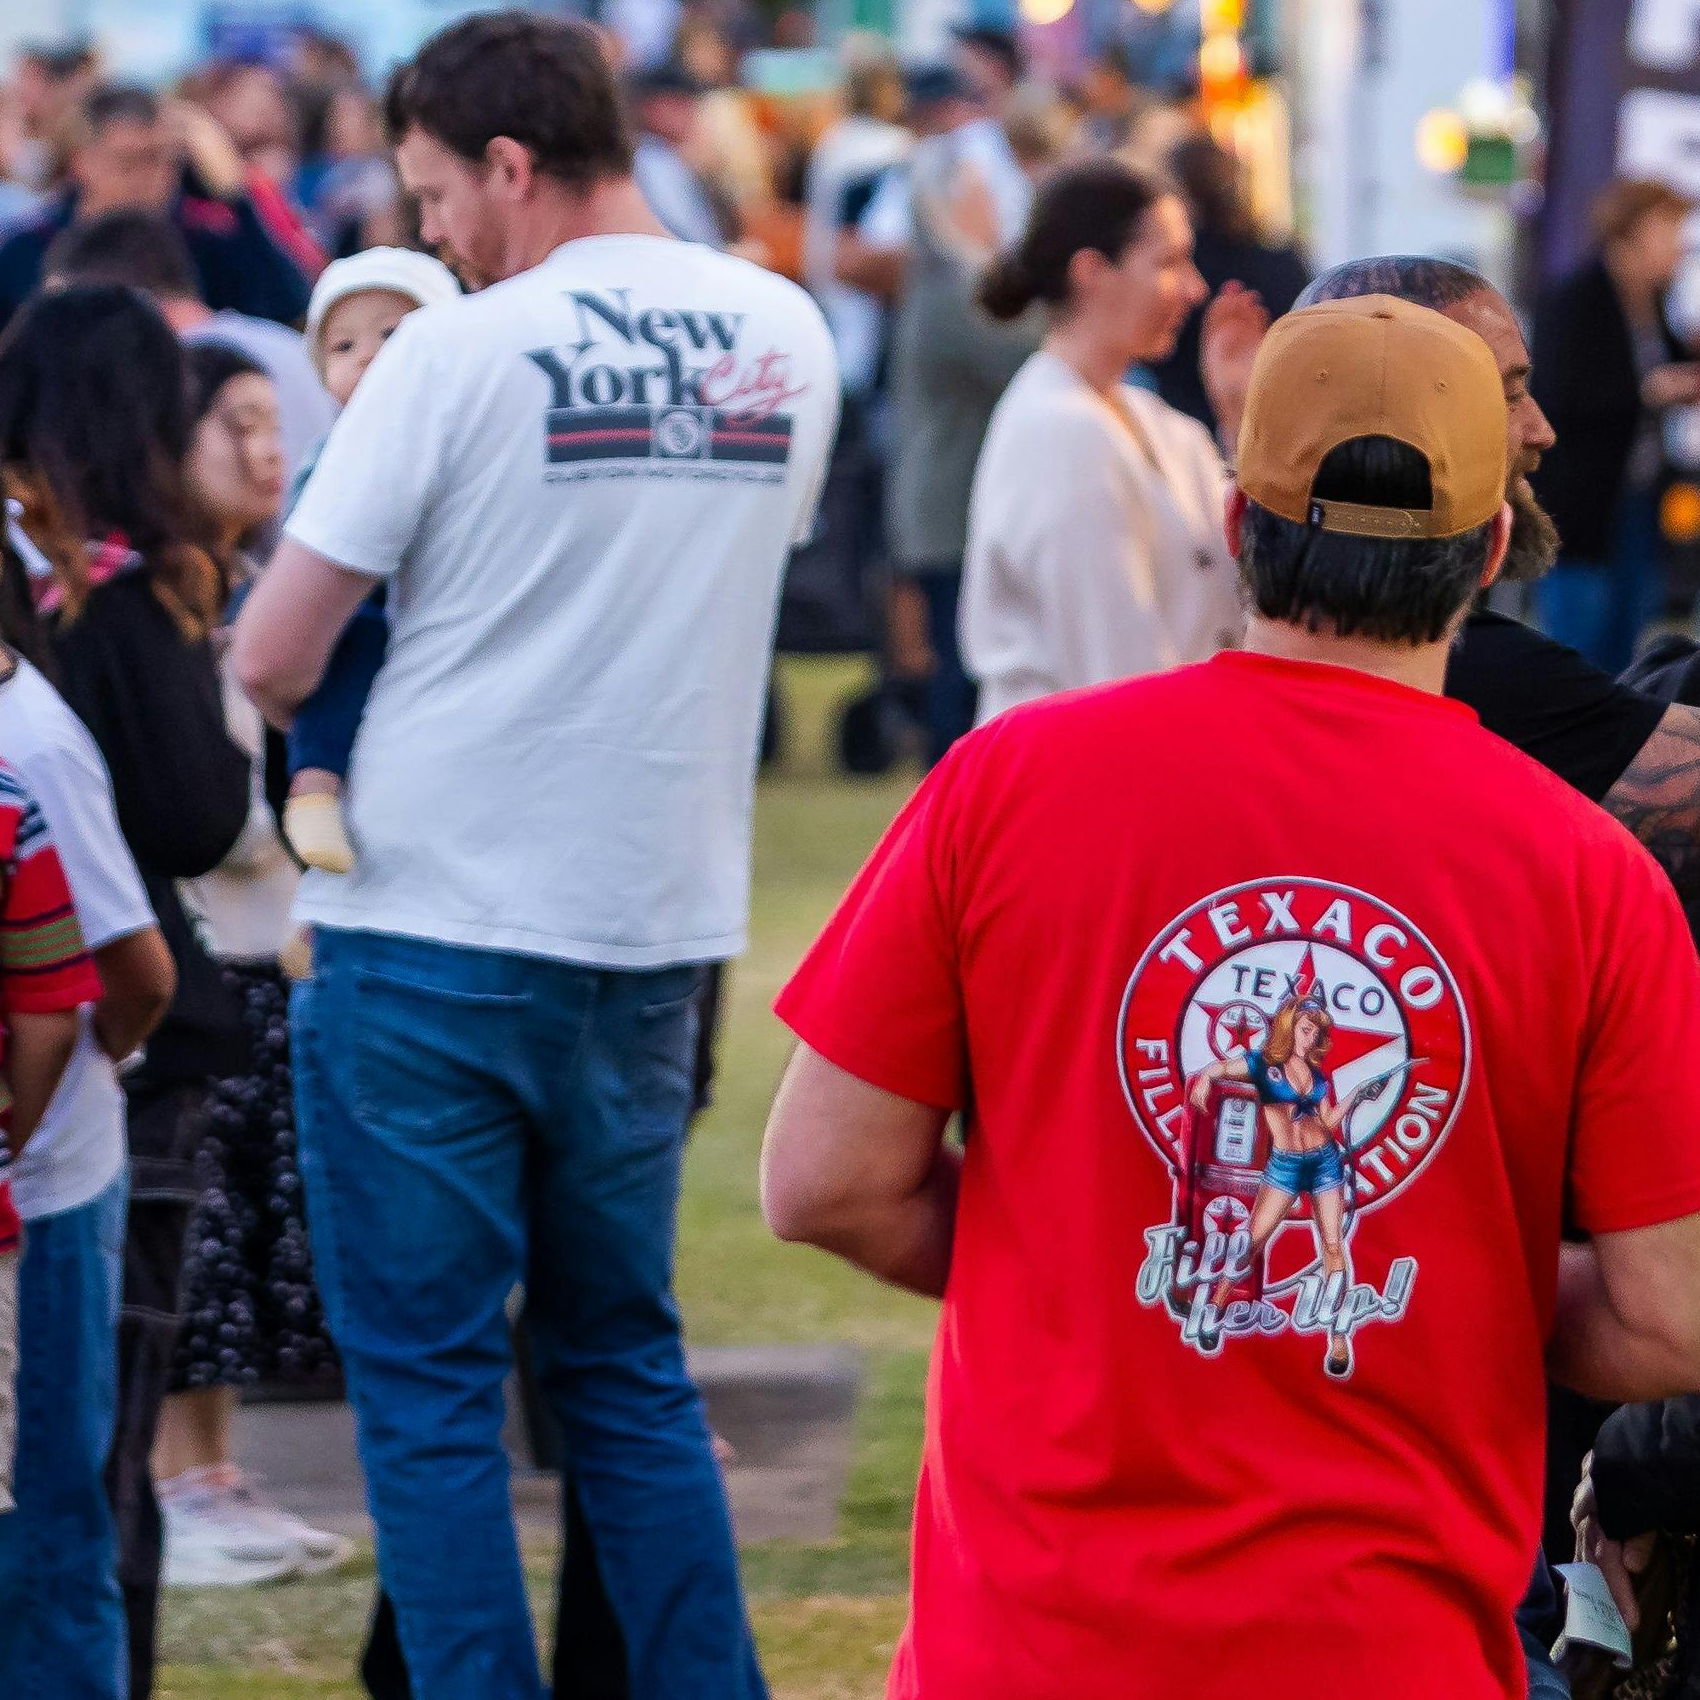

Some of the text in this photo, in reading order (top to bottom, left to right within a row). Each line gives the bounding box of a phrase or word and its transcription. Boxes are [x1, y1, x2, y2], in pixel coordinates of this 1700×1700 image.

[562, 287, 748, 351] New
[523, 340, 812, 429] York City
[1157, 890, 1444, 1010] TEXACO
[1230, 963, 1385, 1017] TEXACO
[1135, 1037, 1450, 1201] FILL ATION
[1137, 1224, 1253, 1305] Fill
[1184, 1256, 1417, 1339] her Up!
